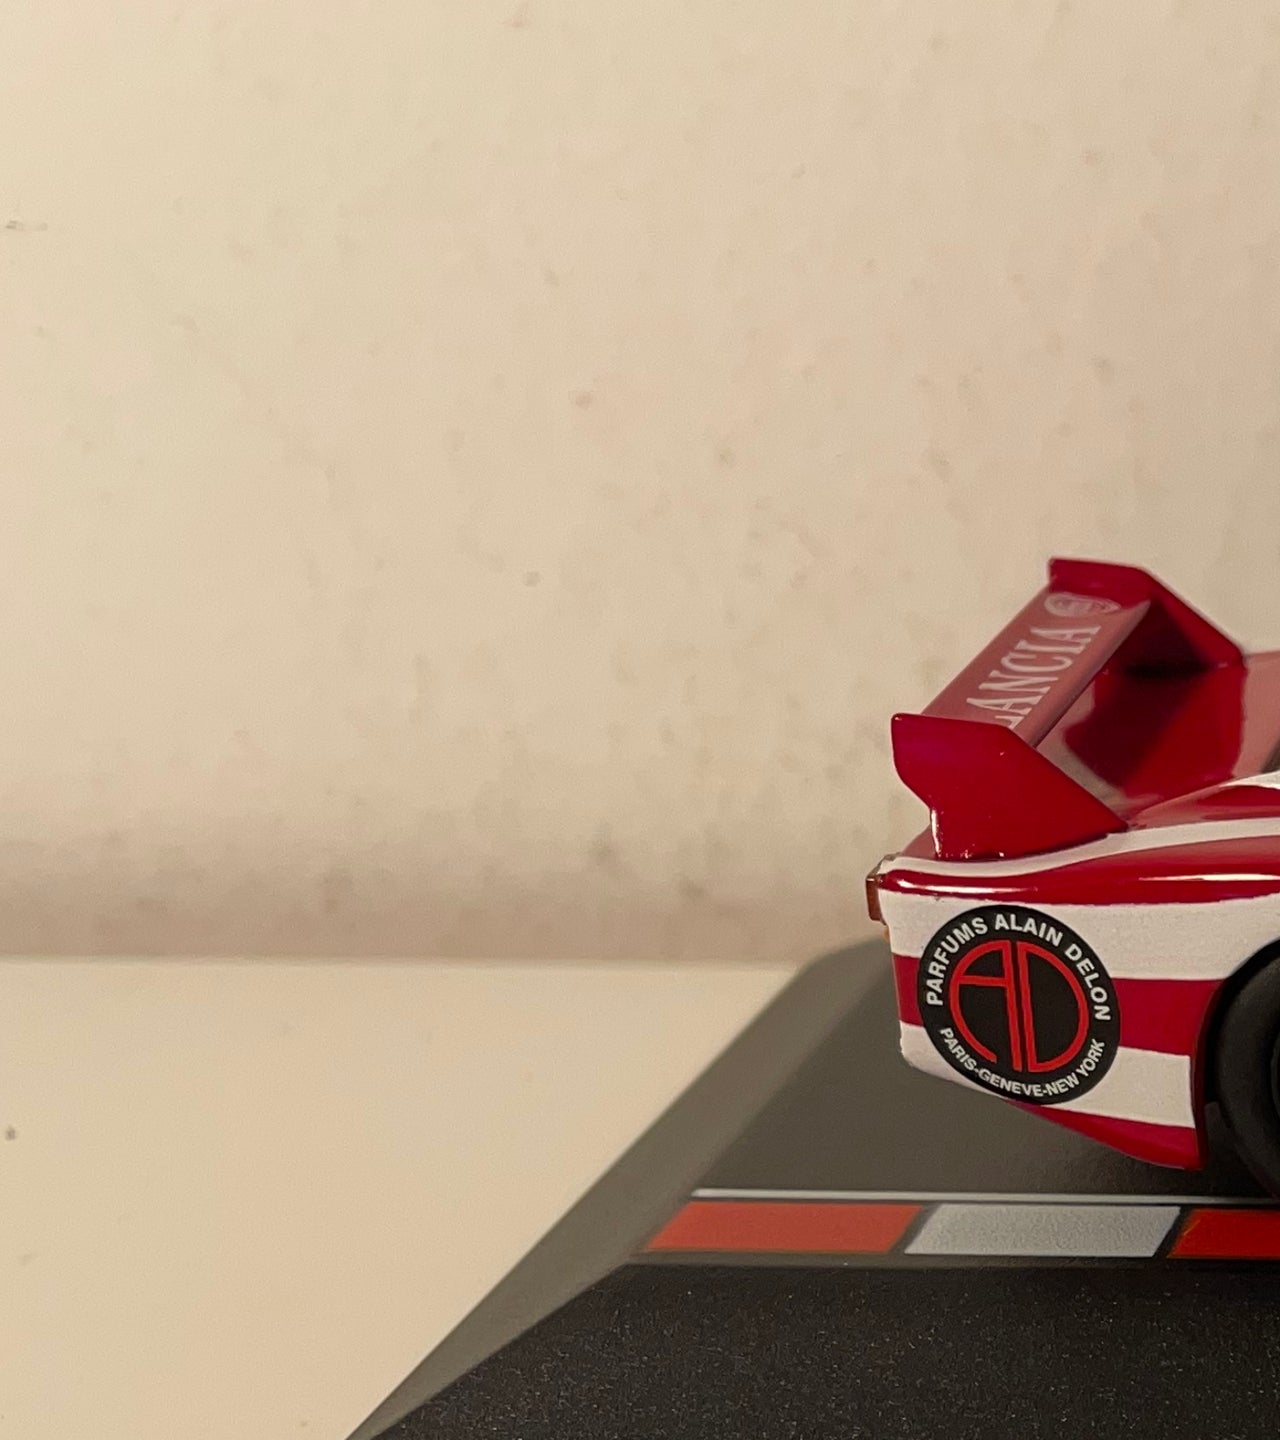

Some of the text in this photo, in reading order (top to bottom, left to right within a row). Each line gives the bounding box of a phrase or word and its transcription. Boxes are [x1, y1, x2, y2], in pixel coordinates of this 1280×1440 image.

[927, 914, 1111, 1021] PARFUMS ALAIN DELON
[1077, 1038, 1105, 1077] YORK
